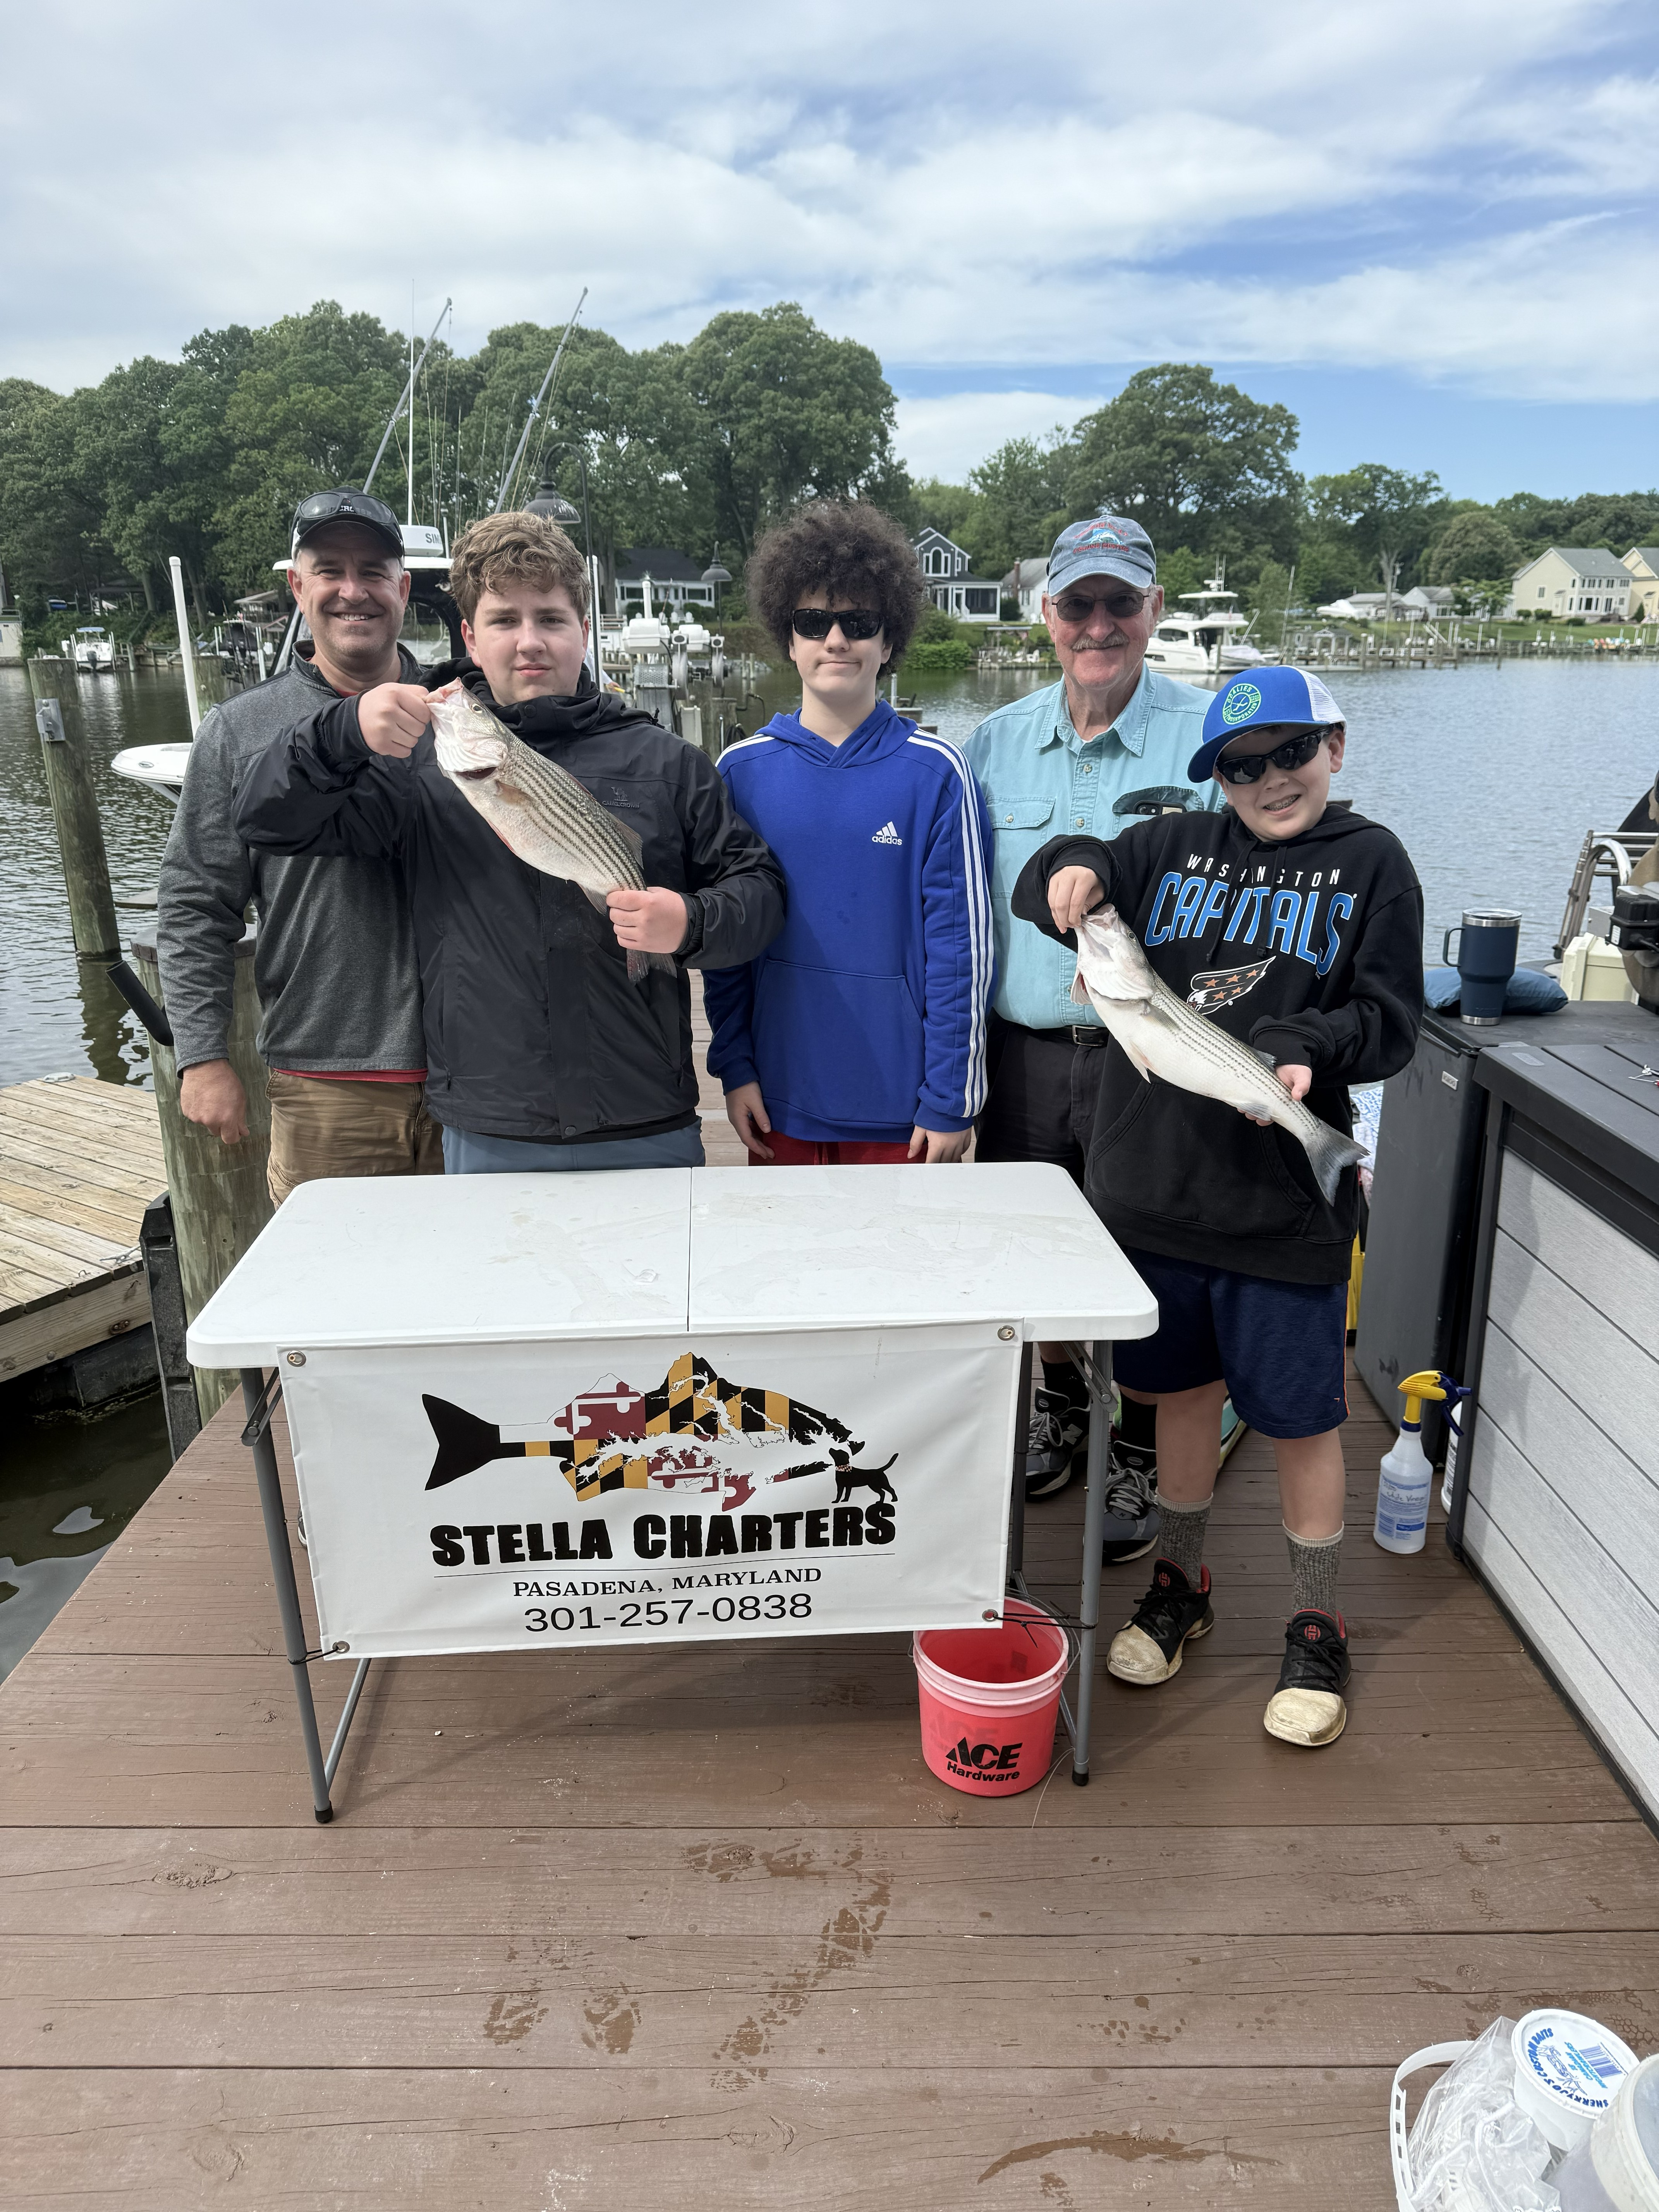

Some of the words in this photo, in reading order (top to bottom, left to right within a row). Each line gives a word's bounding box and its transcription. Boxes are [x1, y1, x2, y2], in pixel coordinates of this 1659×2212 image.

[872, 835, 903, 845] adidas
[1145, 872, 1353, 975] CAPITALS
[430, 1519, 613, 1566] STELLA
[633, 1503, 896, 1559] CHARTERS
[513, 1580, 663, 1596] PASADENA,
[672, 1568, 821, 1590] MARYLAND
[524, 1593, 812, 1632] 301-257-0838
[945, 1736, 1023, 1770] ACE
[947, 1761, 1020, 1782] Hardware
